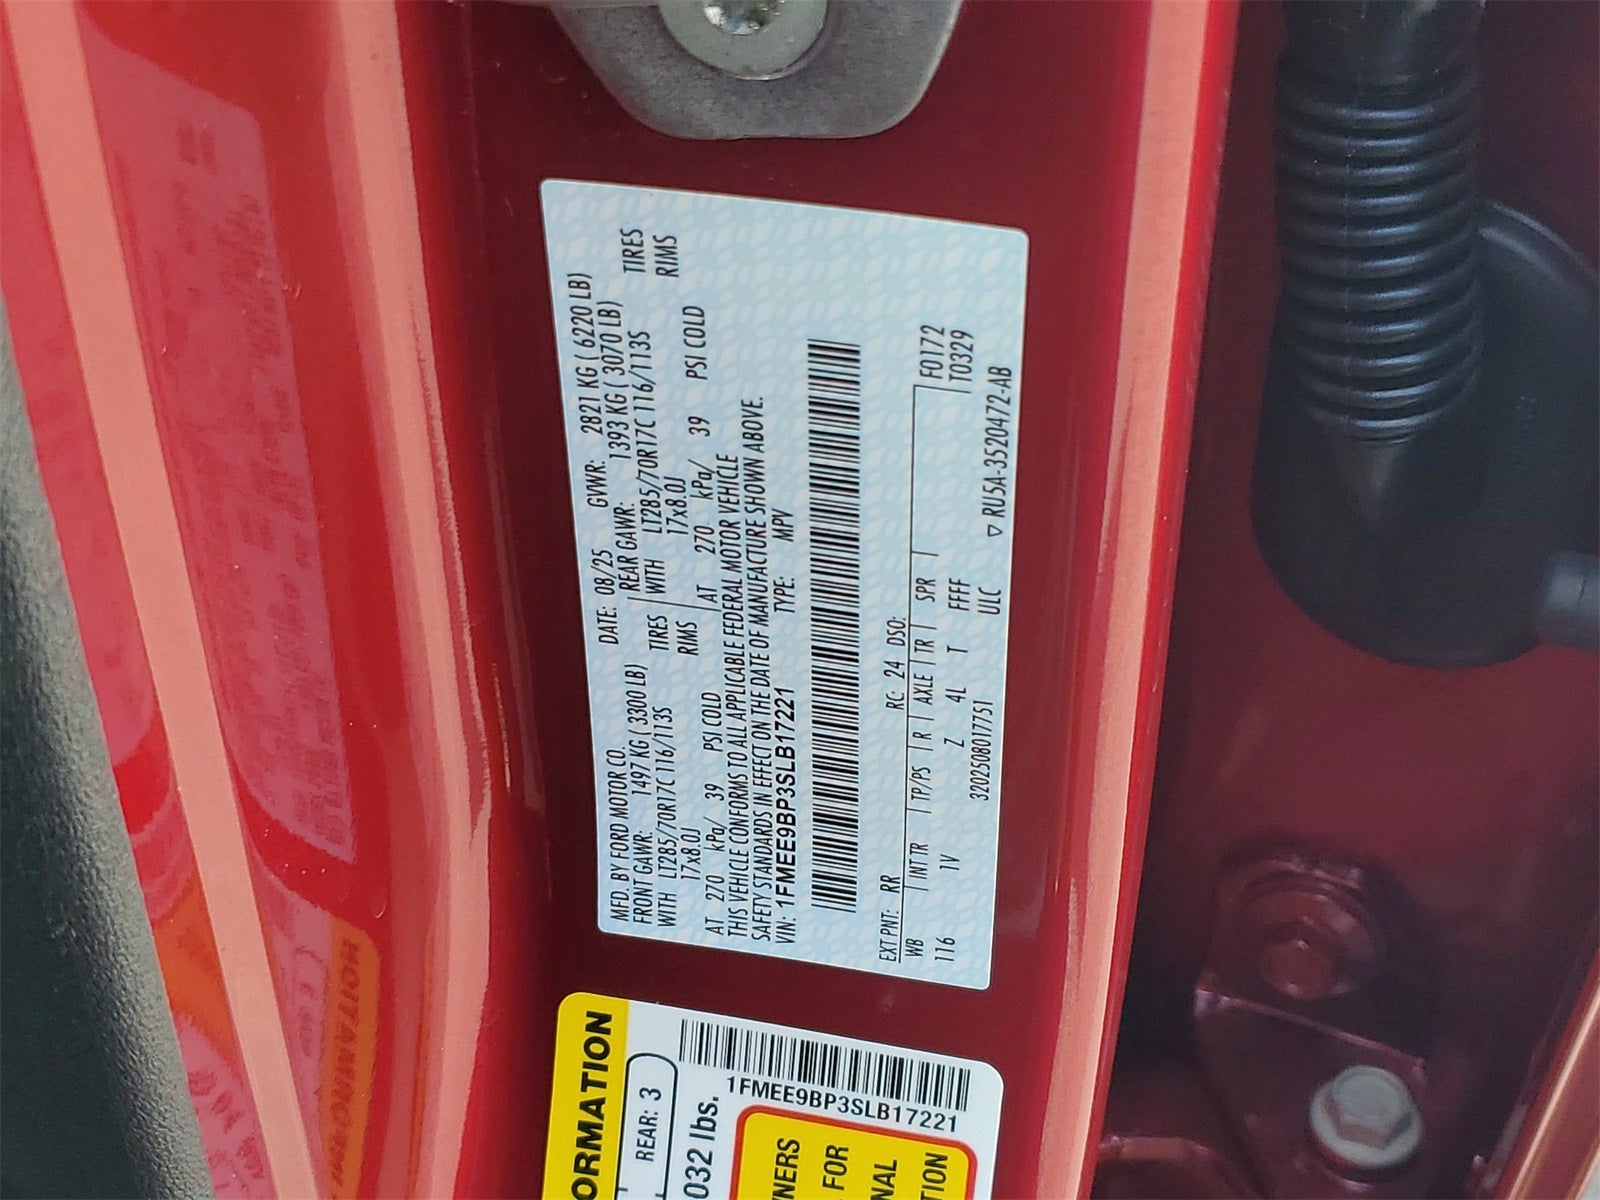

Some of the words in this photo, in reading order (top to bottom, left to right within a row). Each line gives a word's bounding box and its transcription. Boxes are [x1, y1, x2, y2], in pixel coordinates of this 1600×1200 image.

[620, 229, 646, 273] TIRES
[652, 235, 679, 277] RIMS
[567, 273, 592, 299] LB)
[570, 305, 596, 348] 6220
[596, 301, 623, 327] LB)
[682, 306, 706, 348] COLD
[599, 333, 625, 376] 3070
[684, 355, 708, 380] PSI
[919, 325, 945, 379] F0172
[949, 330, 973, 381] T0329
[575, 366, 599, 389] KG
[627, 331, 656, 411] 116/113S
[578, 396, 603, 435] 2821
[604, 393, 628, 415] KG
[606, 421, 631, 459] 1393
[688, 416, 710, 437] 39
[741, 397, 764, 453] ABOVE.
[982, 366, 1012, 518] RU5A-3520472-AB
[584, 460, 609, 508] GVWR:
[631, 418, 663, 534] LT285/70R17C
[687, 459, 715, 500] kPa/
[716, 454, 740, 513] VEHICLE
[743, 457, 766, 515] SHOWN
[663, 476, 688, 535] 17x8.0J
[613, 502, 637, 550] GAWR:
[693, 525, 716, 555] 270
[771, 508, 794, 542] MPV
[719, 519, 742, 573] MOTOR
[590, 549, 617, 595] 08/25
[617, 555, 641, 592] REAR
[644, 559, 666, 594] WITH
[745, 519, 769, 627] MANUFACTURE
[696, 584, 718, 604] AT
[773, 576, 795, 613] TYPE:
[915, 578, 936, 602] SPR
[948, 578, 970, 611] FFFF
[977, 587, 1001, 615] ULC
[596, 606, 619, 644] DATE:
[721, 579, 744, 637] FEDERAL
[647, 614, 669, 650] TIRES
[675, 621, 699, 656] RIMS
[748, 629, 769, 649] OF
[914, 639, 934, 653] TR
[947, 645, 968, 653] T
[624, 664, 648, 686] LB)
[723, 641, 747, 722] APPLICABLE
[749, 652, 770, 687] DATE
[883, 661, 905, 679] 24
[750, 690, 771, 715] THE
[886, 691, 904, 710] RC:
[913, 673, 933, 705] AXLE
[945, 688, 966, 703] 4L
[626, 690, 648, 725] 3300
[701, 692, 722, 727] COLD
[652, 706, 676, 772] 116/113S
[702, 731, 723, 752] PSI
[726, 726, 748, 749] ALL
[751, 720, 771, 740] ON
[912, 732, 932, 740] R
[944, 738, 964, 748] Z
[606, 747, 626, 767] CO.
[629, 740, 650, 758] KG
[727, 752, 748, 768] TO
[751, 743, 772, 788] EFFECT
[969, 700, 993, 801] 3202508017751
[607, 771, 629, 819] MOTOR
[630, 762, 652, 795] 1497
[704, 784, 724, 801] 39
[909, 766, 932, 800] TP/PS
[727, 773, 749, 844] CONFORMS
[753, 792, 773, 807] IN
[774, 687, 796, 908] 1FMEE9BP3SLB17221
[610, 823, 630, 859] FORD
[655, 778, 679, 879] LT285/70R17C
[703, 817, 728, 852] kPa/
[632, 831, 653, 874] GAWR:
[680, 827, 701, 880] 17x8.0J
[752, 810, 773, 889] STANDARDS
[909, 843, 928, 855] TR
[939, 854, 960, 870] 1V
[610, 863, 630, 882] BY
[728, 848, 749, 902] VEHICLE
[880, 875, 900, 893] RR
[909, 858, 928, 879] INT
[610, 888, 629, 922] MFD.
[633, 878, 653, 924] FRONT
[705, 875, 725, 902] 270
[657, 892, 677, 926] WITH
[705, 916, 724, 936] AT
[728, 907, 748, 937] THIS
[751, 892, 772, 941] SAFETY
[880, 910, 899, 937] PNT:
[775, 917, 796, 943] VIN:
[905, 938, 924, 957] WB
[879, 938, 897, 962] EXT
[935, 937, 955, 961] 116
[639, 1087, 662, 1101] 3
[727, 1076, 957, 1133] 1FMEE9BP3SLB17221
[635, 1110, 659, 1162] REAR:
[689, 1096, 719, 1141] lbs.
[822, 1144, 849, 1191] FOR
